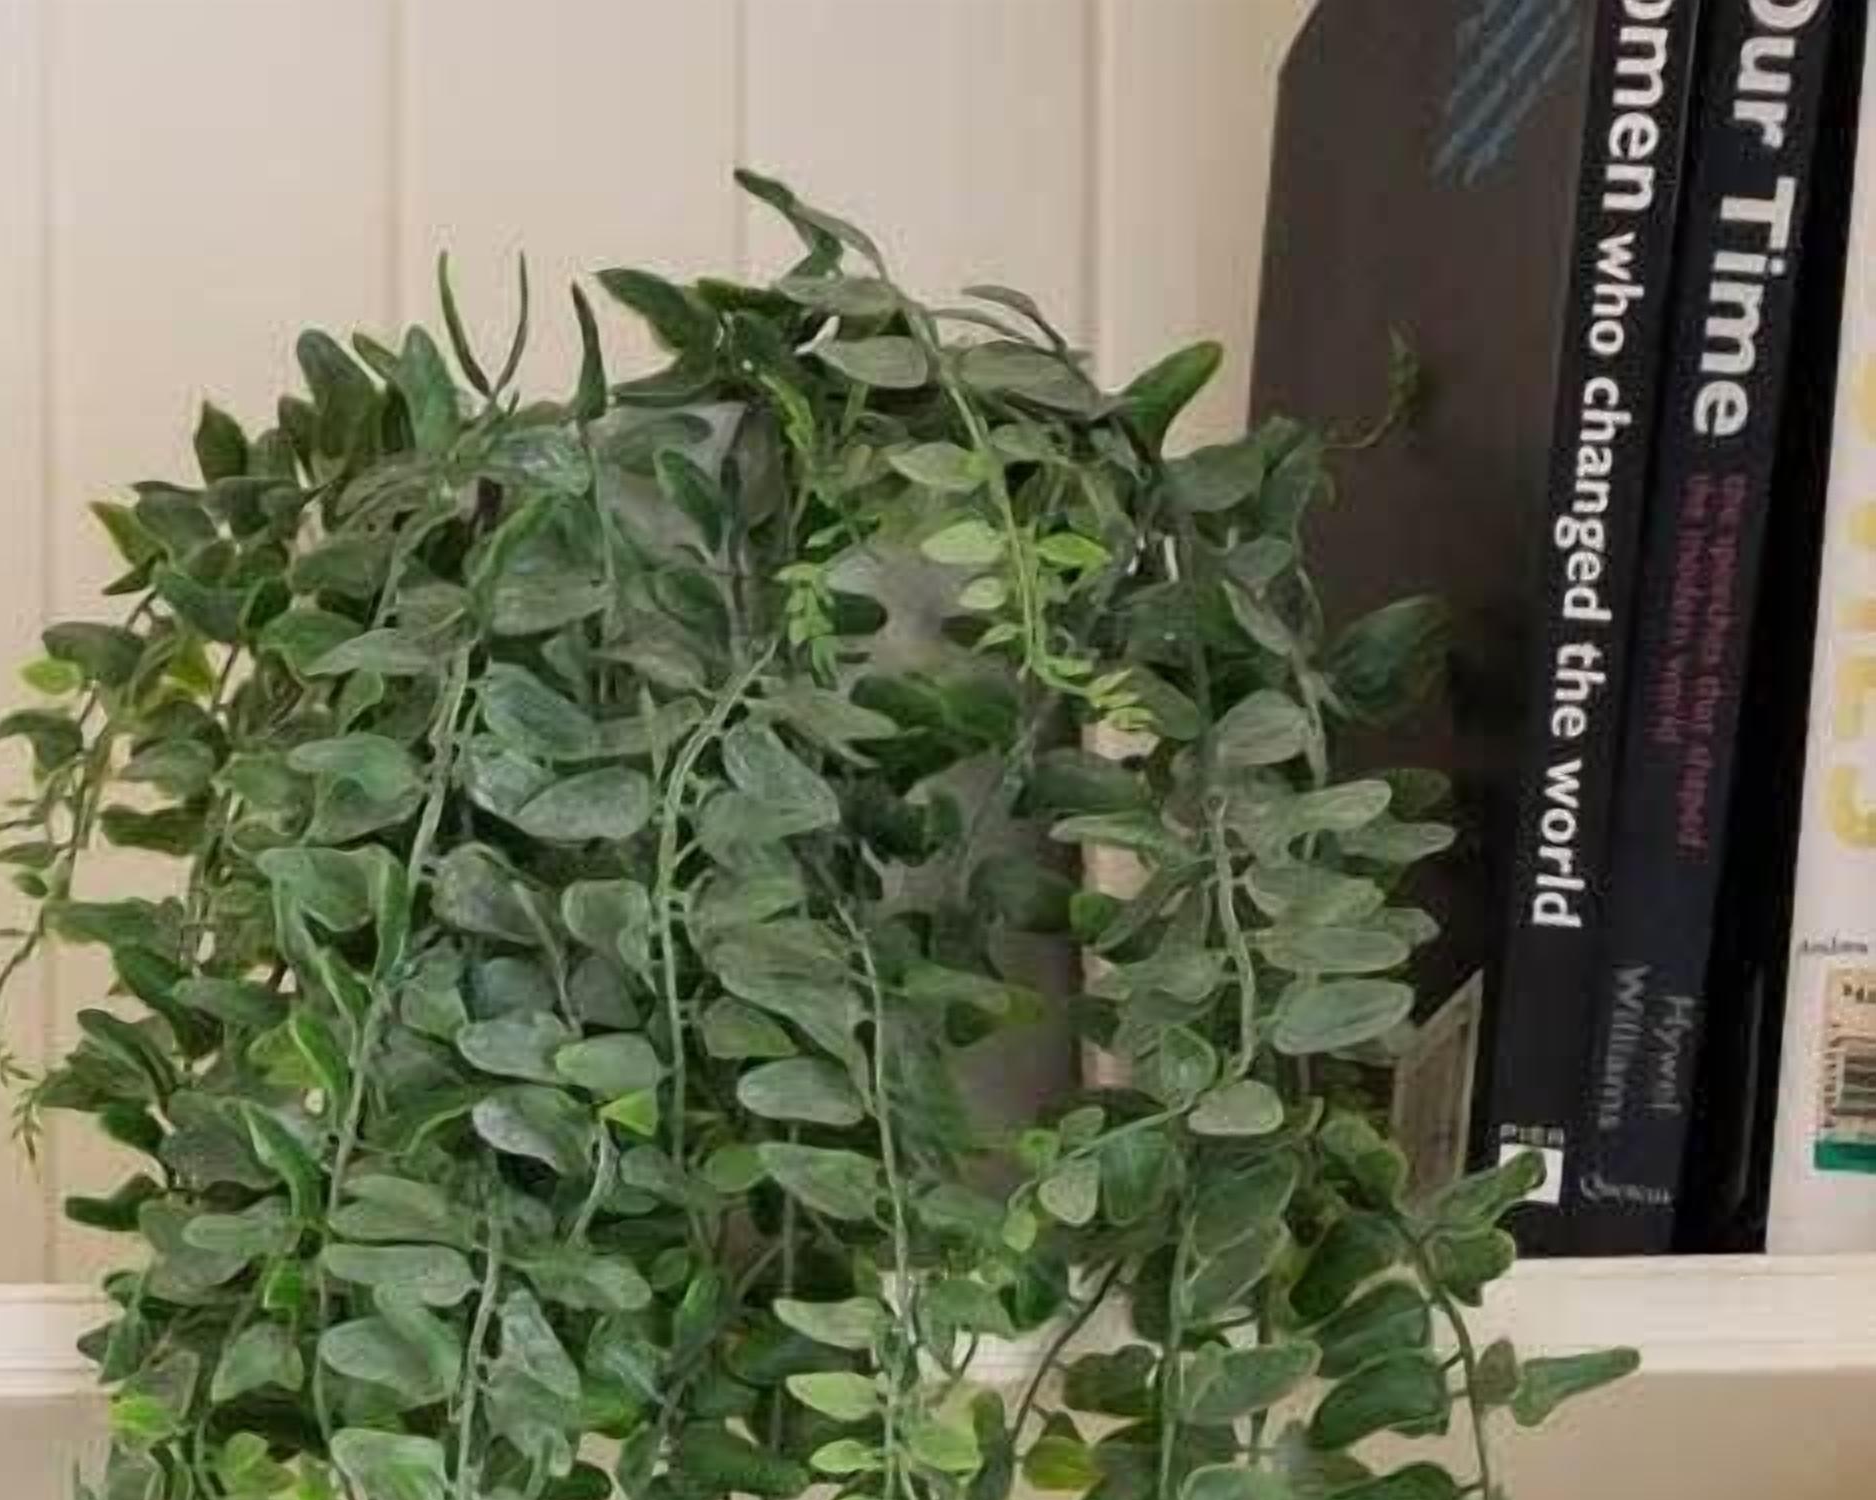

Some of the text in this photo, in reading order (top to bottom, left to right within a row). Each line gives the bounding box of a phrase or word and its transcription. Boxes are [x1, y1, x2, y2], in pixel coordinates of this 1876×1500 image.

[1588, 232, 1645, 355] who
[1693, 176, 1799, 438] Time
[1554, 377, 1634, 622] changed
[1549, 641, 1608, 741] the
[1531, 759, 1587, 929] world
